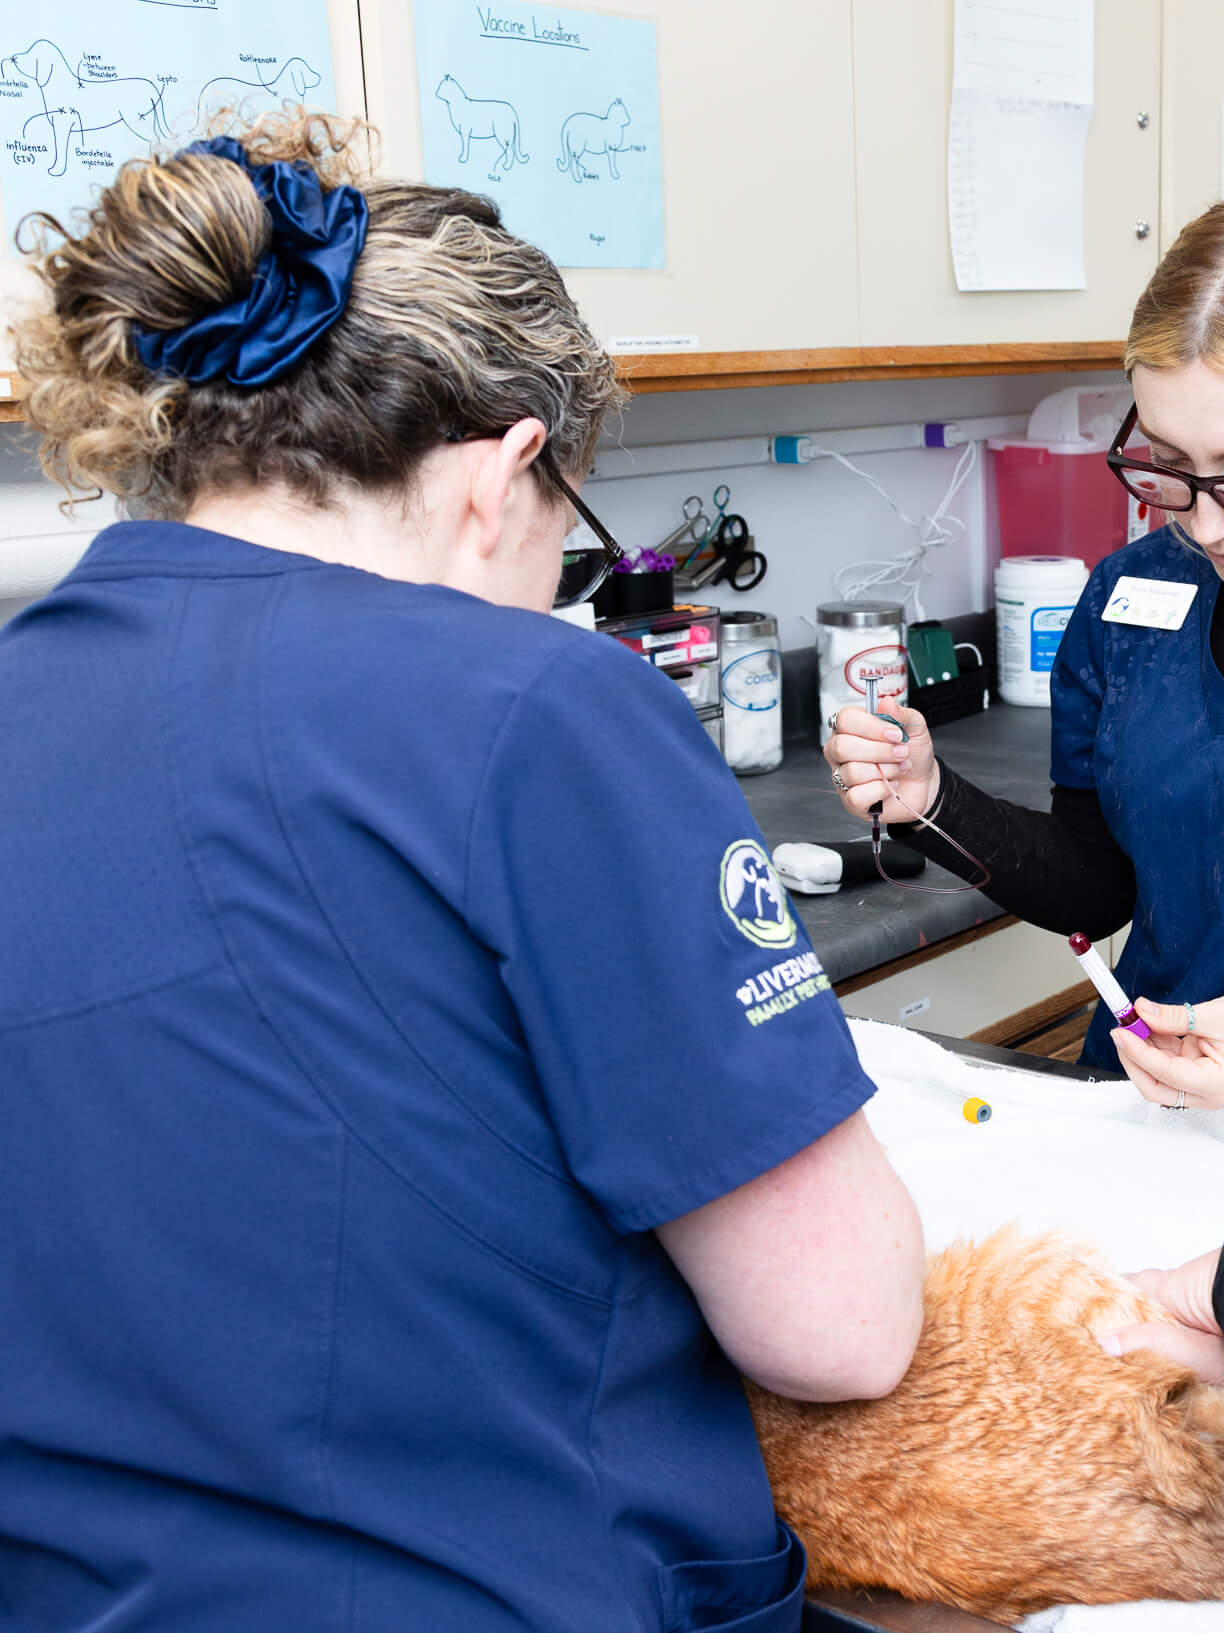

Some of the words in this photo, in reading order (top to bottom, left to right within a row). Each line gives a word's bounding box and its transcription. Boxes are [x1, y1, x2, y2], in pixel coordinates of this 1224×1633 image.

[476, 6, 526, 35] Vaccine
[532, 16, 580, 43] Locations
[157, 74, 177, 85] Lepto
[6, 140, 48, 153] influenza
[745, 988, 799, 1027] FAMILY
